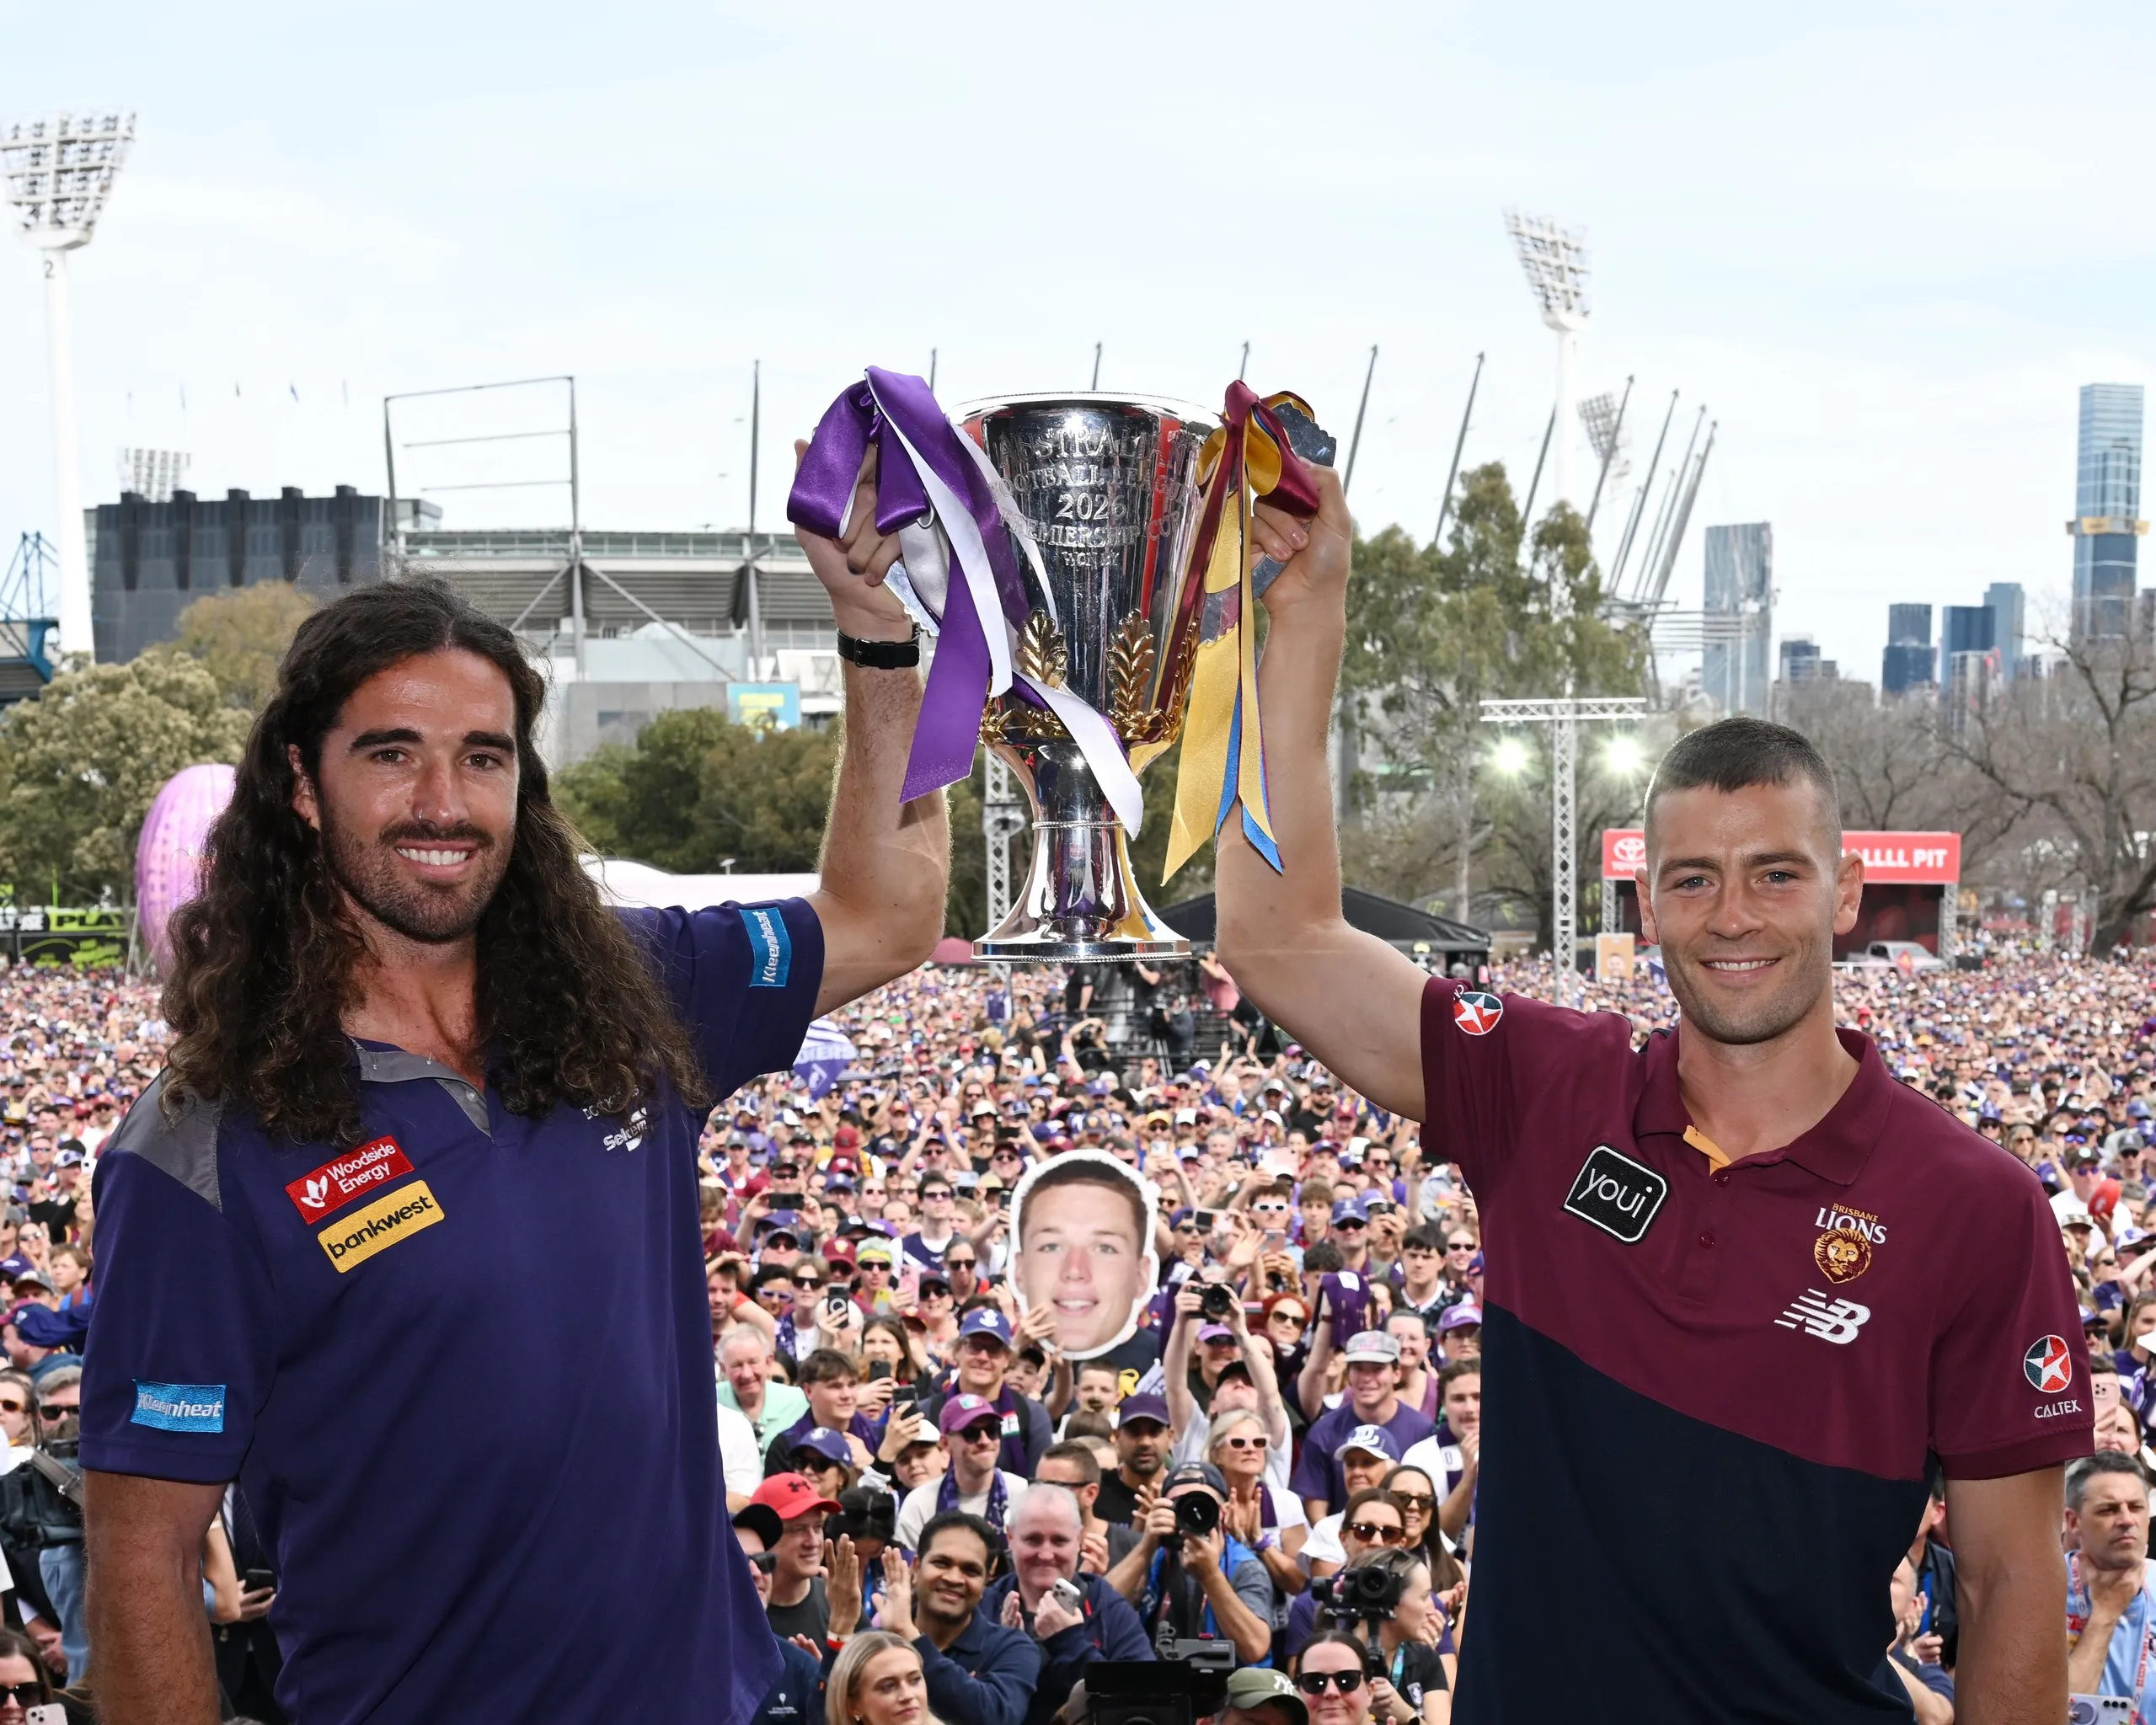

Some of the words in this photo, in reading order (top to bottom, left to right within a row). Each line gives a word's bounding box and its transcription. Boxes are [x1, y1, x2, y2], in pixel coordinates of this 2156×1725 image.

[1056, 492, 1127, 520] 2026
[1913, 848, 1949, 868] PIT
[752, 911, 780, 983] Kleenheat
[327, 1144, 396, 1181] Woodside
[338, 1162, 391, 1194] Energy
[1576, 1167, 1653, 1219] youi
[327, 1195, 434, 1259] bankwest
[1815, 1207, 1888, 1244] LIONS
[1832, 1203, 1879, 1223] BRISBANE
[2034, 1399, 2083, 1418] CALTEX
